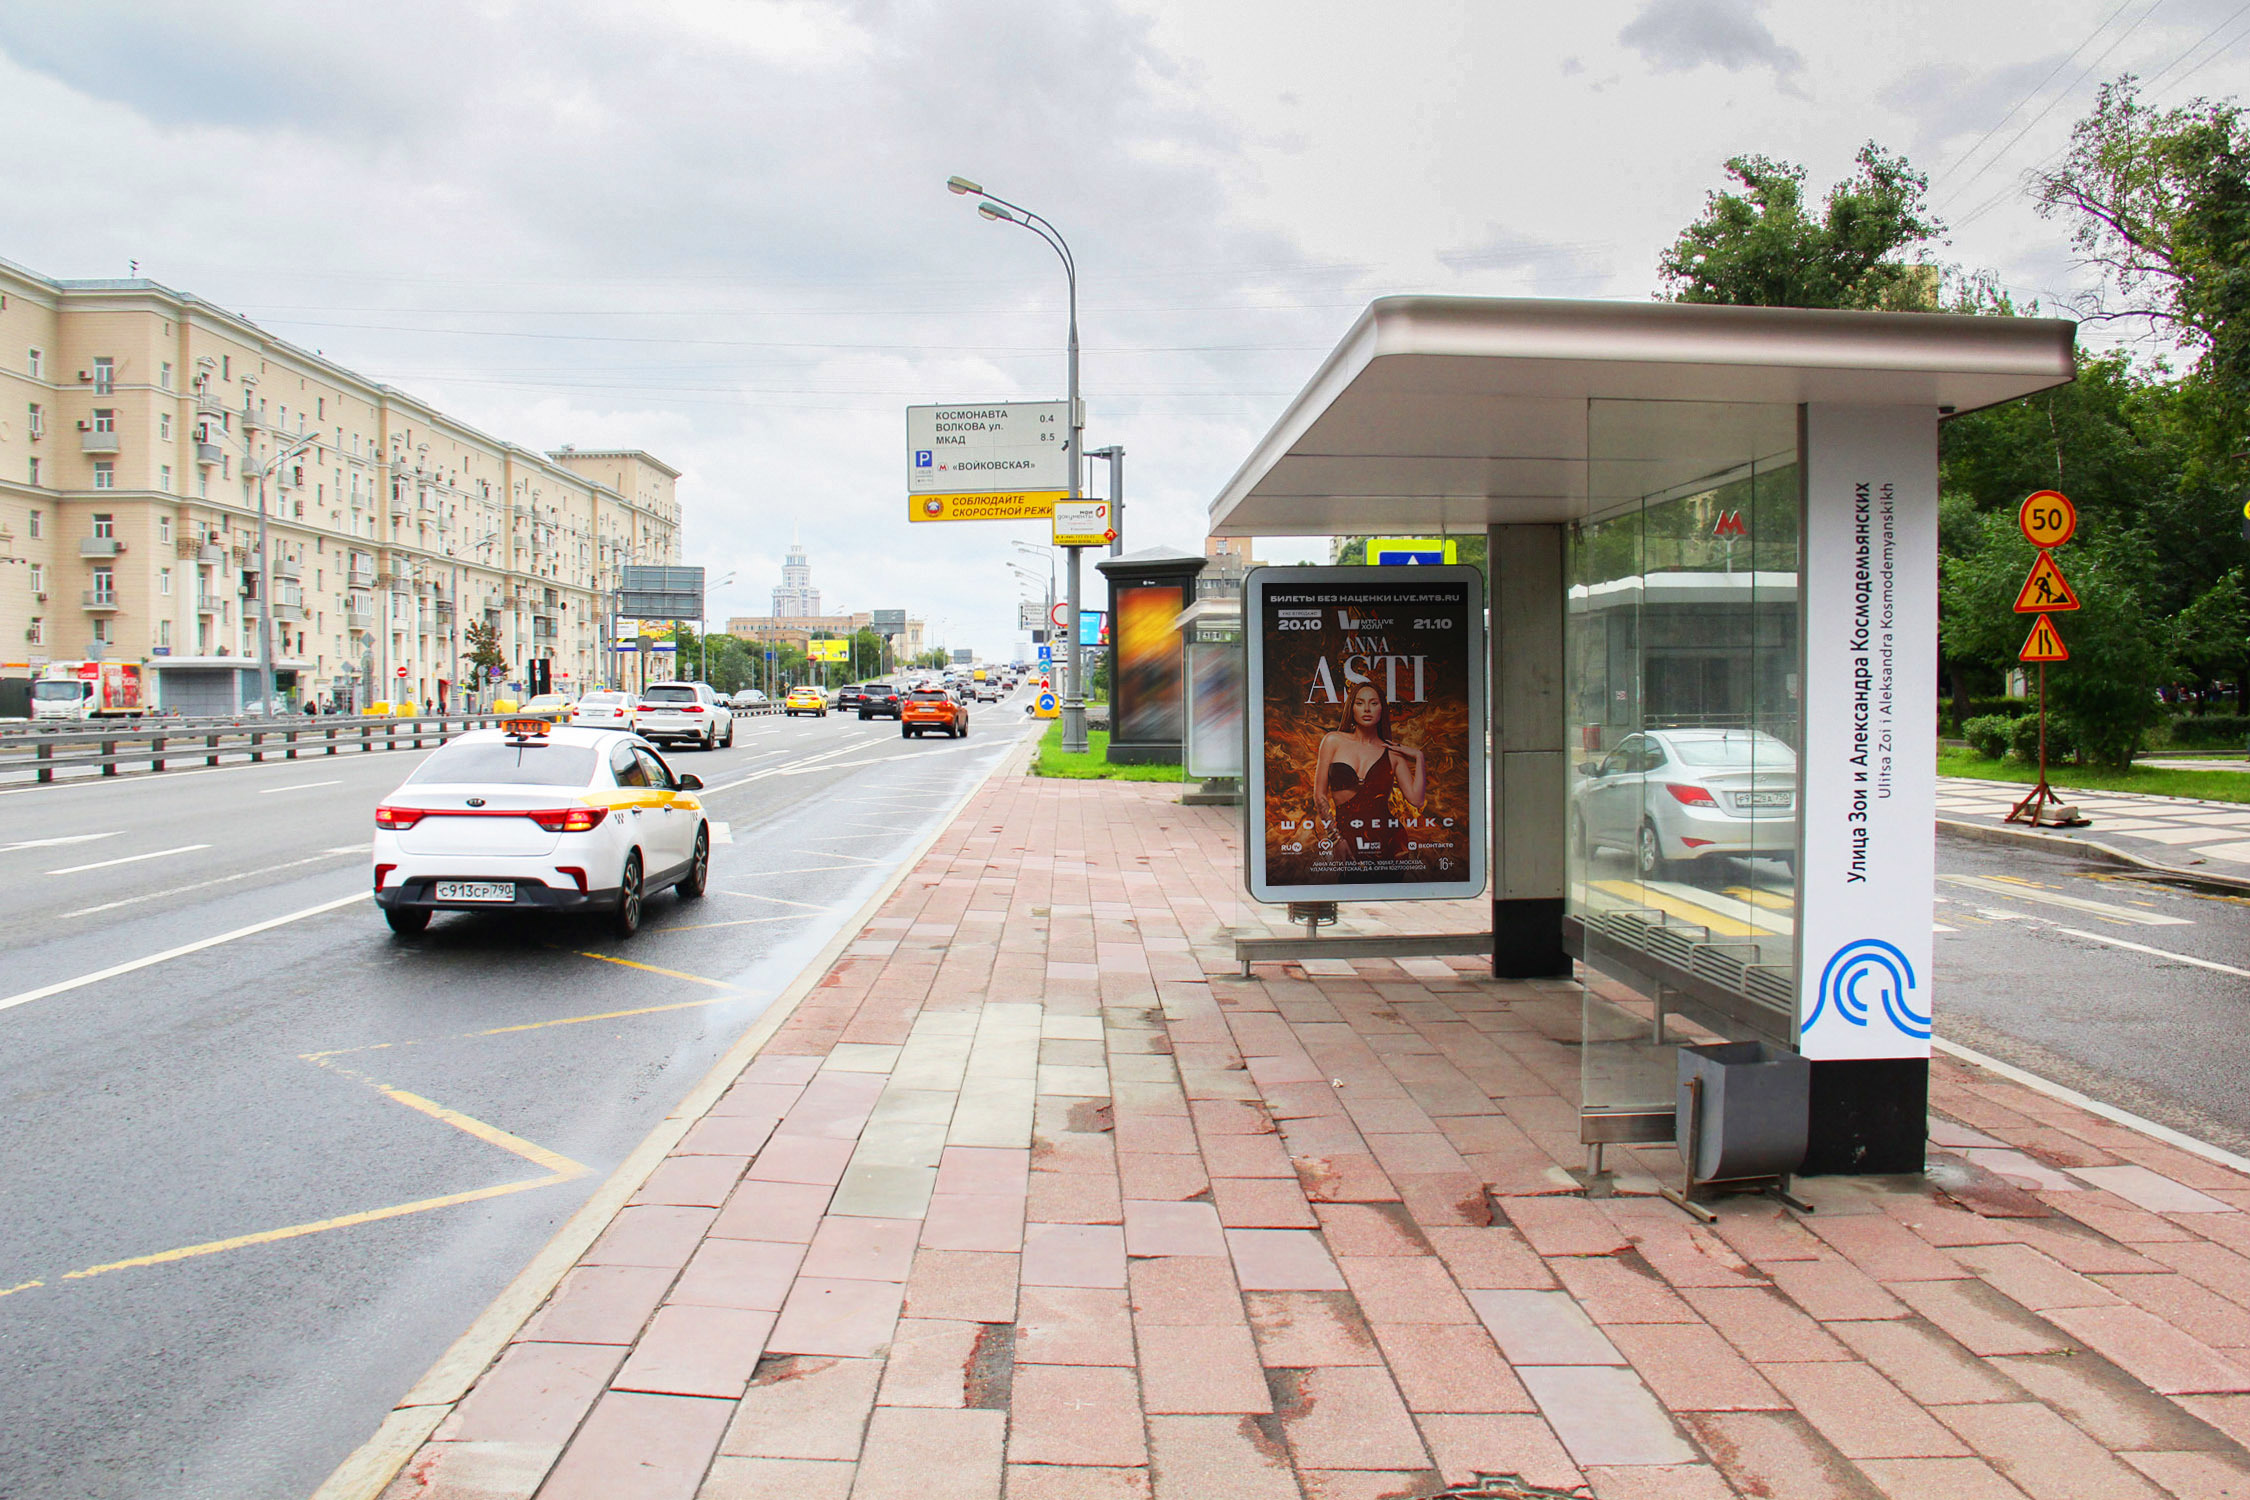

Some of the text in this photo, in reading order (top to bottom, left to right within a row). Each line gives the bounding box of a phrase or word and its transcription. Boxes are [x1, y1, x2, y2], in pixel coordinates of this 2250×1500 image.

[936, 410, 1008, 420] КОСМОНАВТА
[1039, 414, 1054, 423] 0.4
[936, 422, 1004, 432] ВОЛКОВА ул.
[936, 435, 966, 446] МКАД
[1040, 433, 1055, 442] 8.5
[952, 459, 1036, 471] «ВОЙКОВСКАЯ»
[952, 495, 1025, 506] СОБЛЮДАЙТЕ
[952, 505, 1053, 517] СКОРОСТНОЙ РЕЖИ
[2032, 508, 2062, 531] 50
[1880, 483, 1897, 629] Kosmodemyanskikh
[1270, 595, 1316, 603] БИЛЕТЫ
[1339, 595, 1392, 604] НАЦЕНКИ
[1278, 619, 1322, 631] 20.10
[1413, 618, 1453, 630] 21.10
[1342, 636, 1390, 653] ANNA
[1304, 654, 1429, 704] ASTI
[1879, 634, 1893, 715] Aleksandra
[1847, 482, 1873, 883] Улица Зои и Александра Космодемьянских
[1879, 729, 1891, 752] Zoi
[1878, 757, 1891, 799] Ulitsa
[1281, 817, 1454, 830] ШОУ ФЕНИКС
[1439, 857, 1454, 871] 16+
